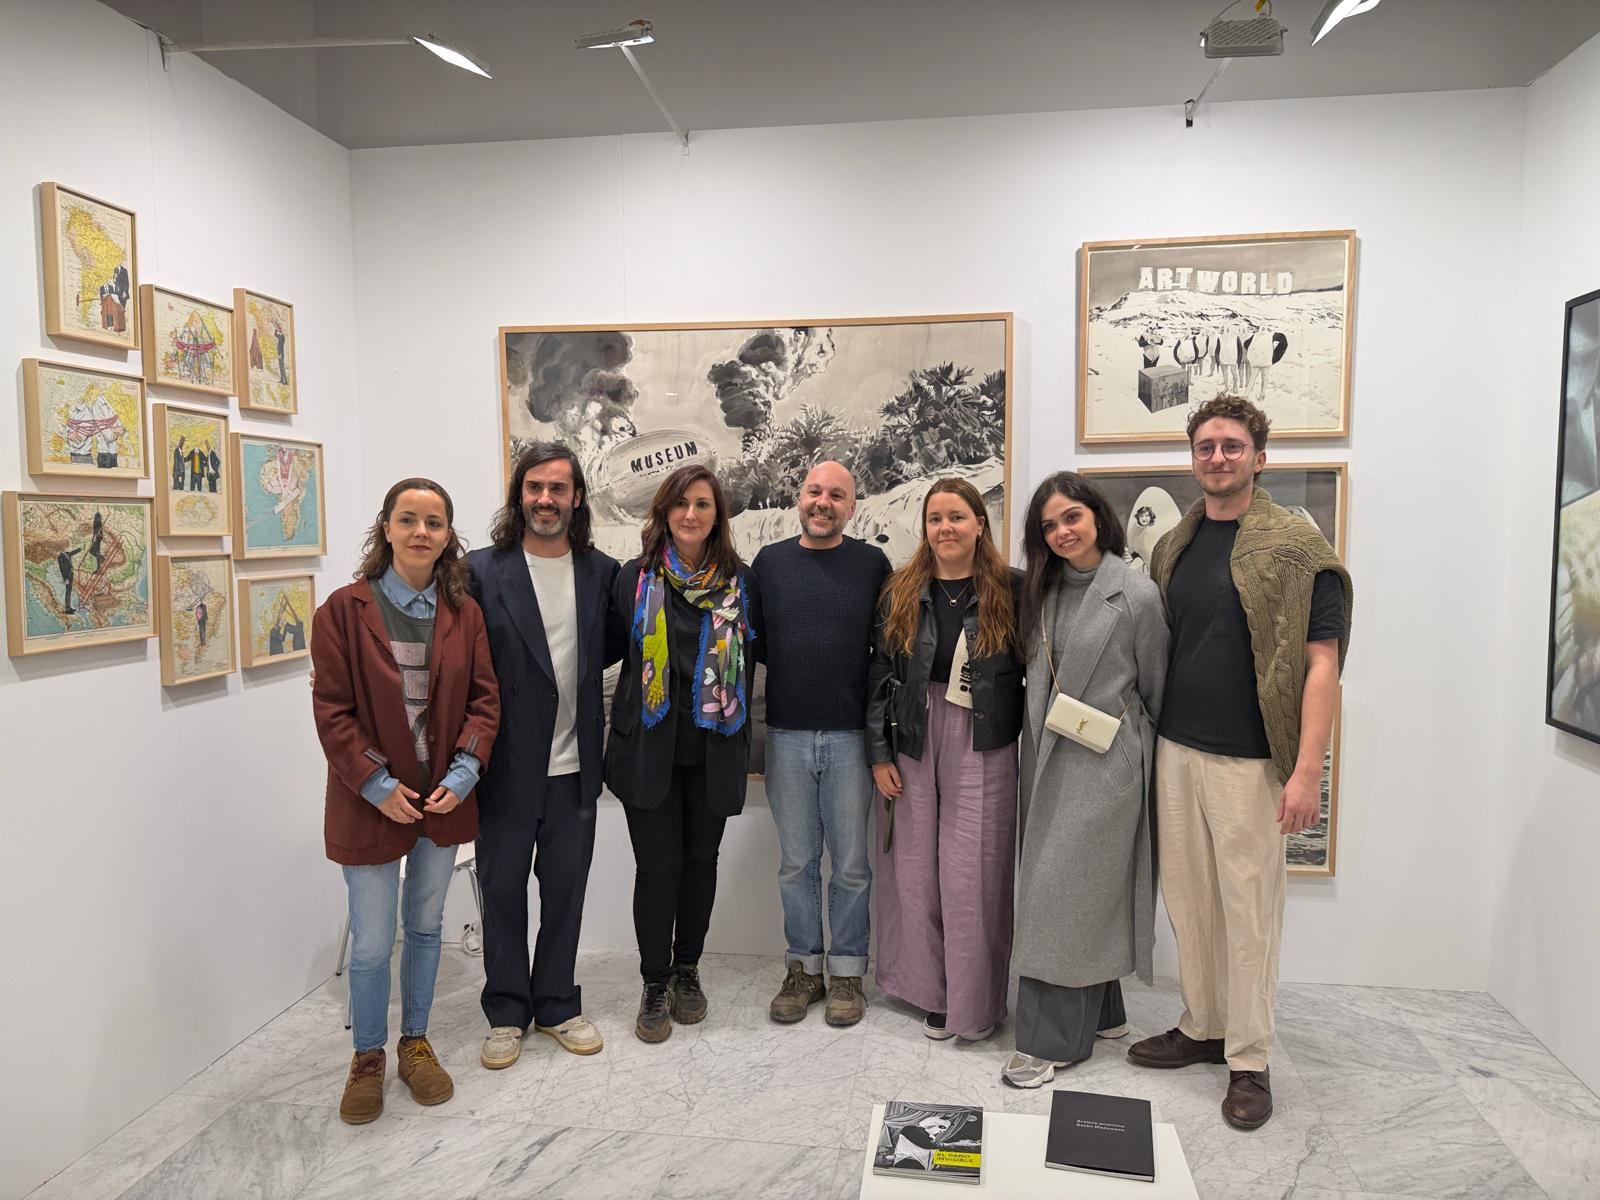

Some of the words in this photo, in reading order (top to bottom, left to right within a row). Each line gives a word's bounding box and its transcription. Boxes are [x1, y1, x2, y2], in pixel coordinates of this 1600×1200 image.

[1138, 266, 1193, 291] ART
[1196, 270, 1293, 295] WORLD
[630, 441, 698, 472] MUSEUM
